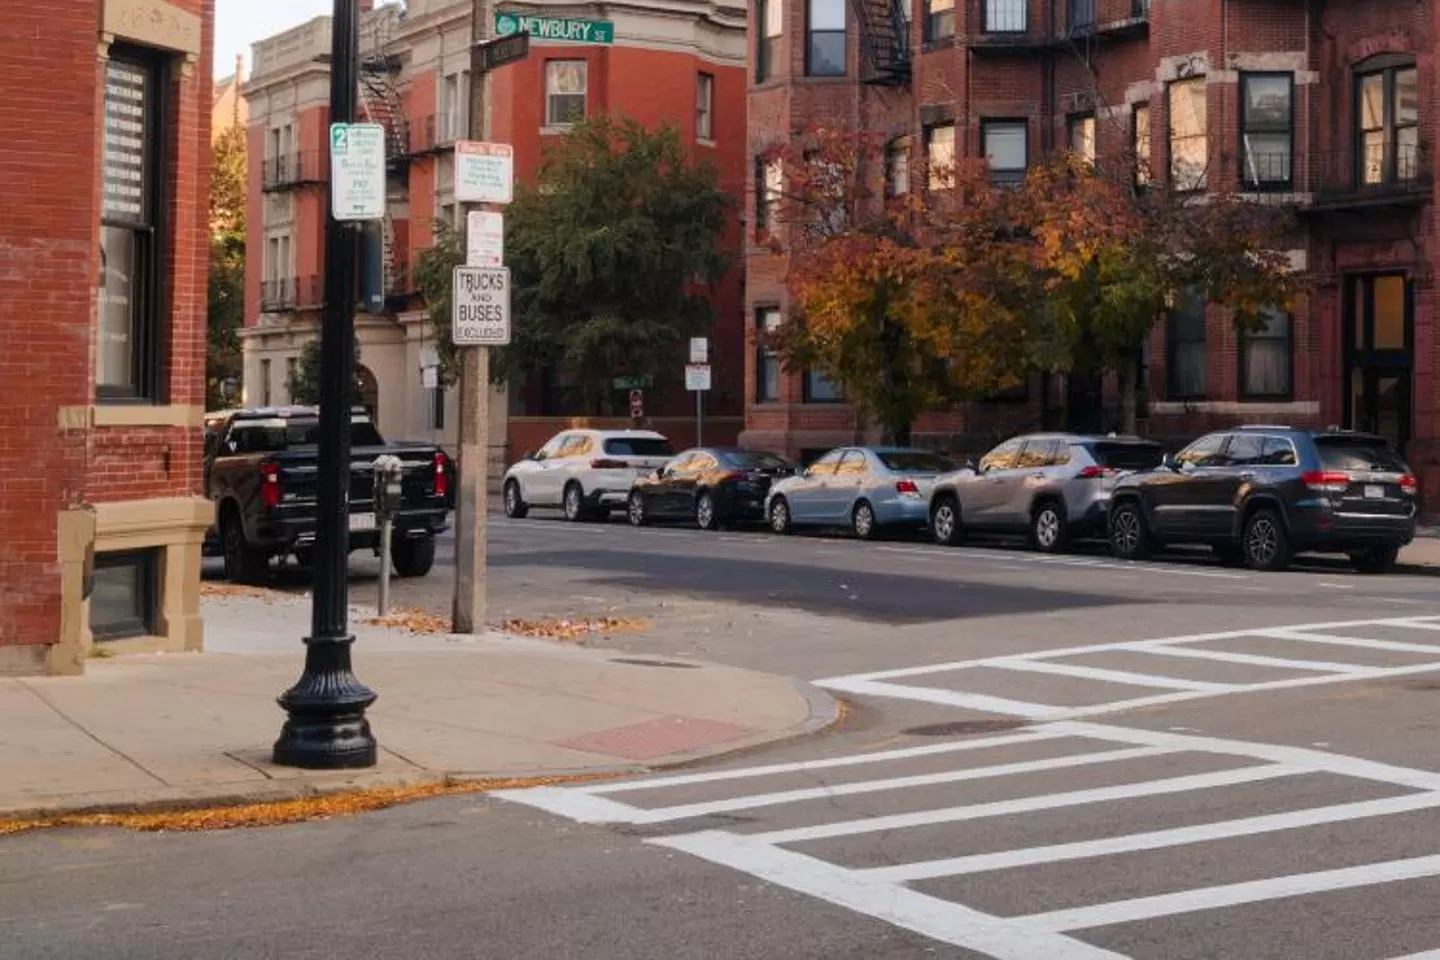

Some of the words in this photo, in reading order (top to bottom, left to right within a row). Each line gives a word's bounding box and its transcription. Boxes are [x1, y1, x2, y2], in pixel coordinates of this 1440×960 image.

[518, 16, 592, 40] NEWBURY
[335, 128, 346, 147] 2
[460, 273, 504, 290] TRUCKS
[470, 293, 493, 302] AND
[459, 305, 502, 321] BUSES
